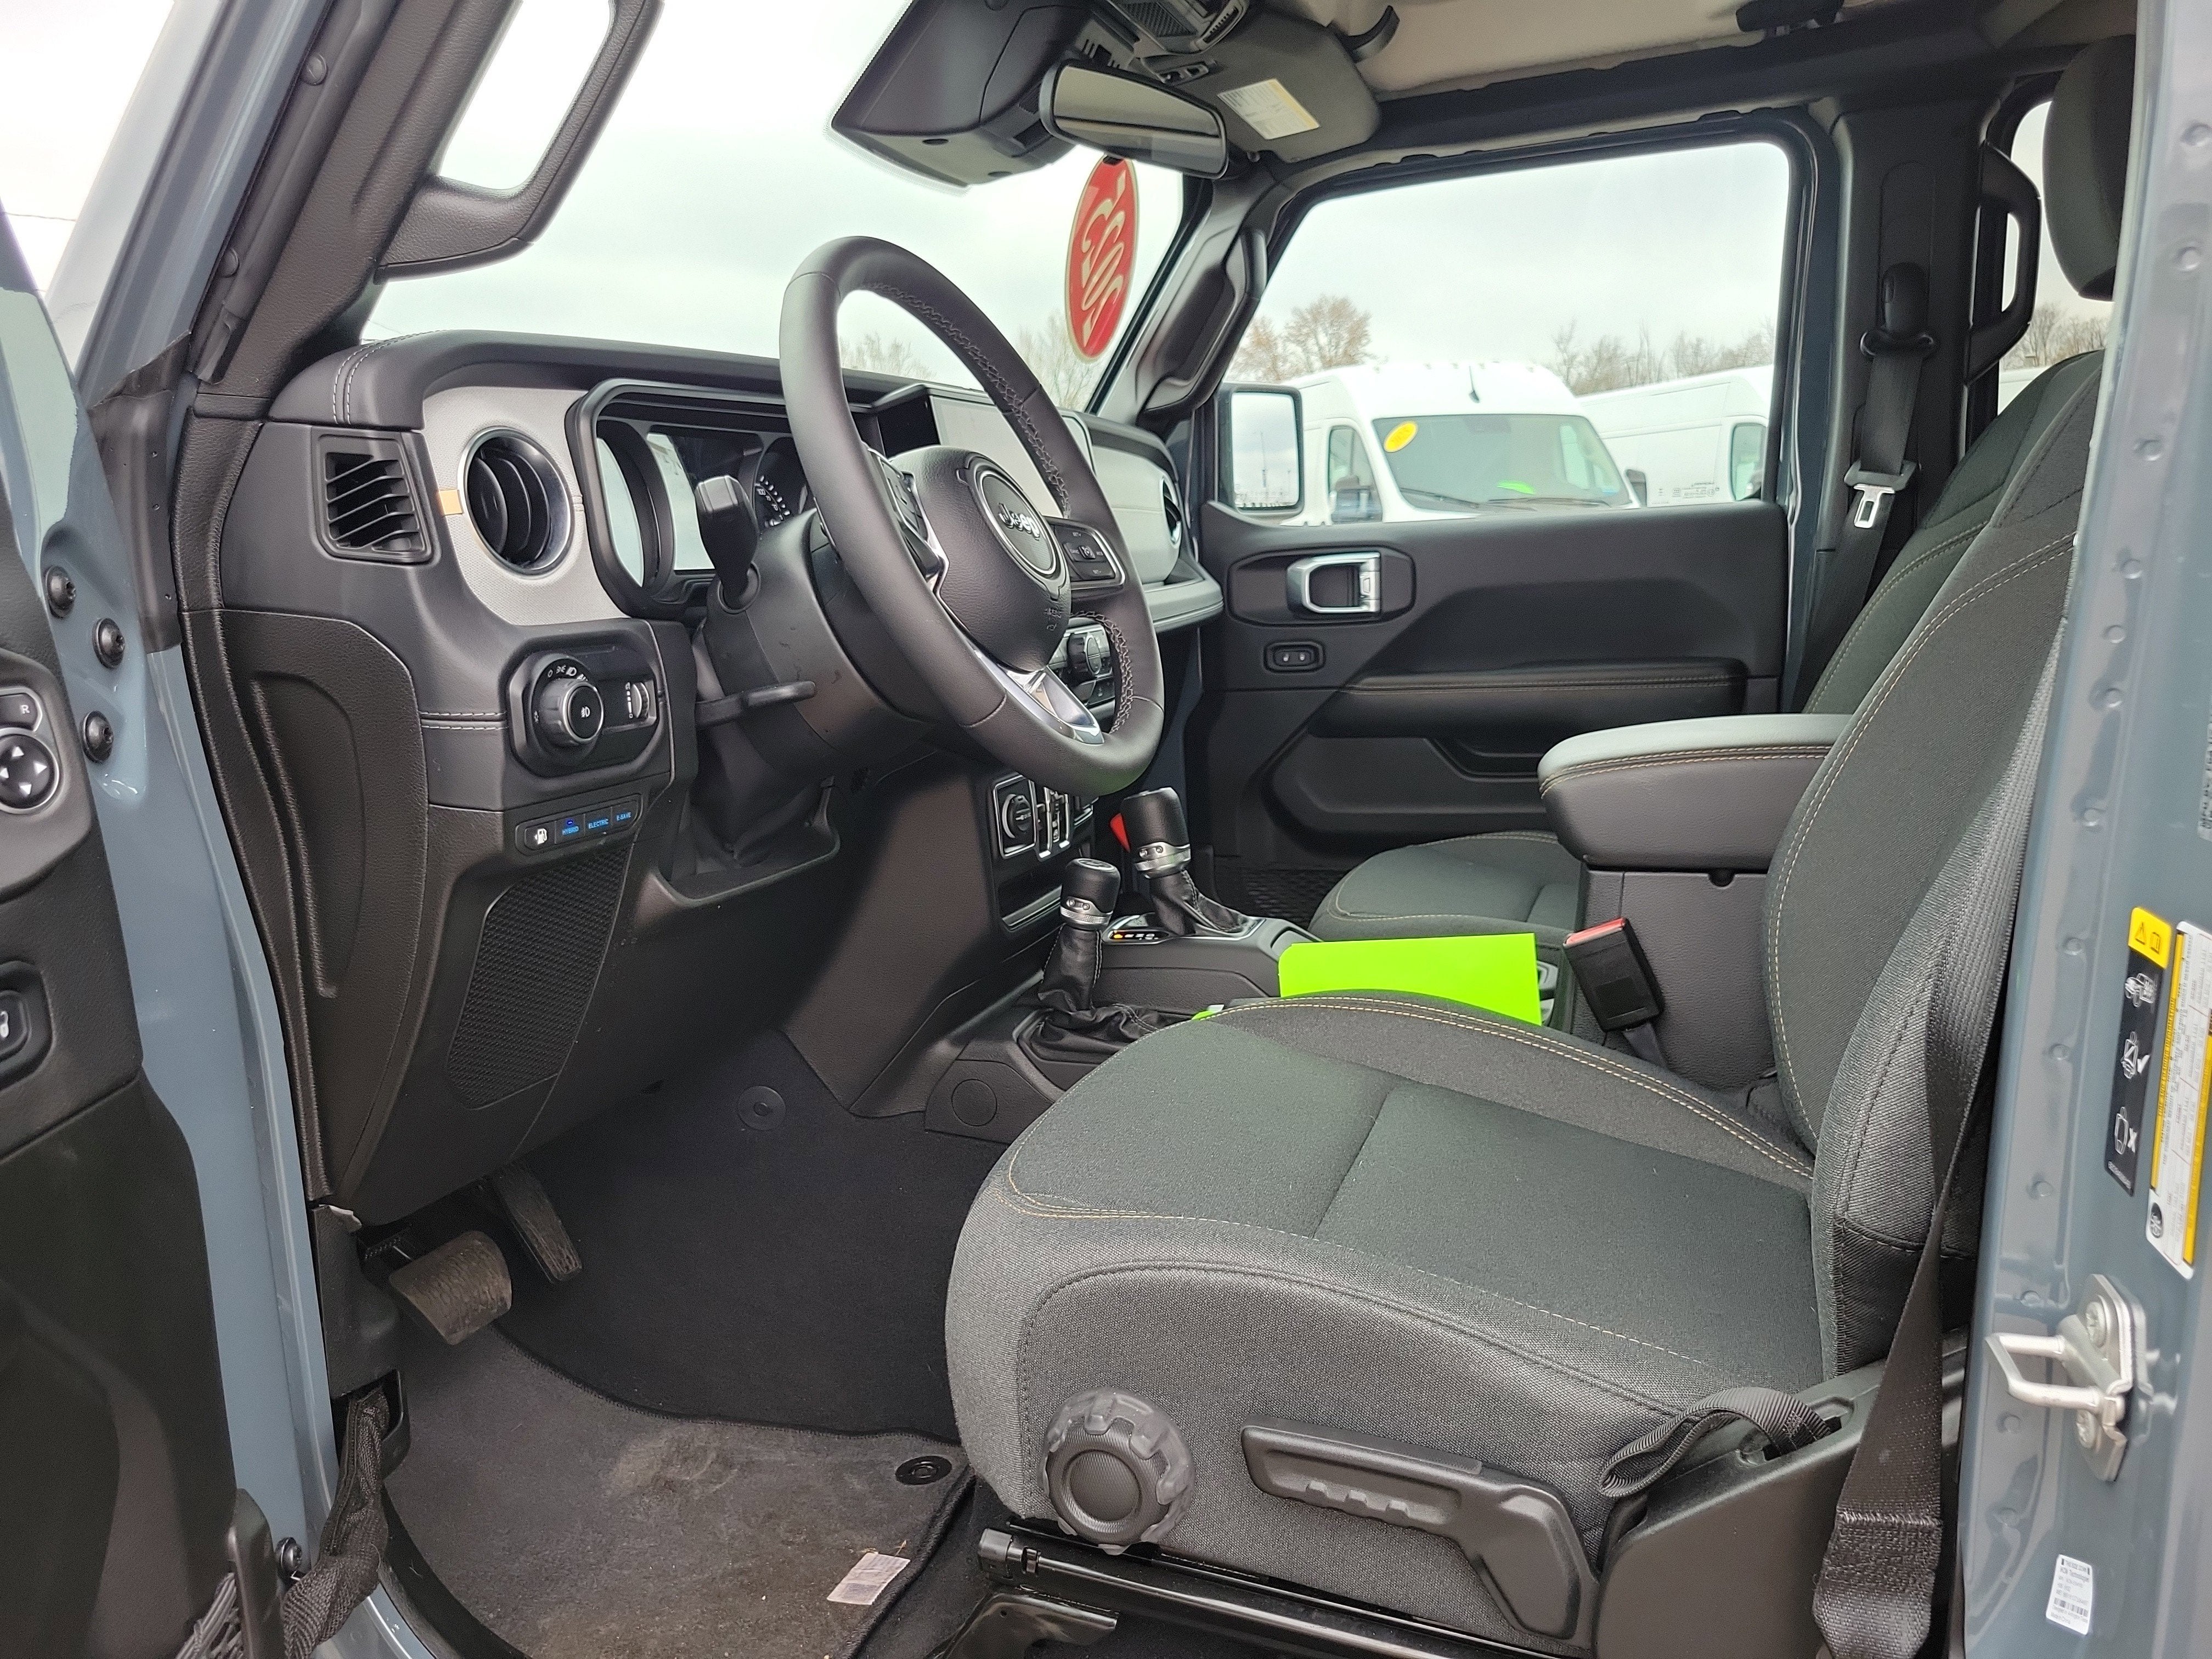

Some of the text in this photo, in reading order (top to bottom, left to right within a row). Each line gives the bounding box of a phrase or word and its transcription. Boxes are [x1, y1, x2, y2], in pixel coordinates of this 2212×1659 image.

[998, 503, 1040, 540] Jeep
[20, 704, 30, 714] R
[588, 818, 609, 829] ELECTRIC
[562, 826, 579, 836] HYBRID
